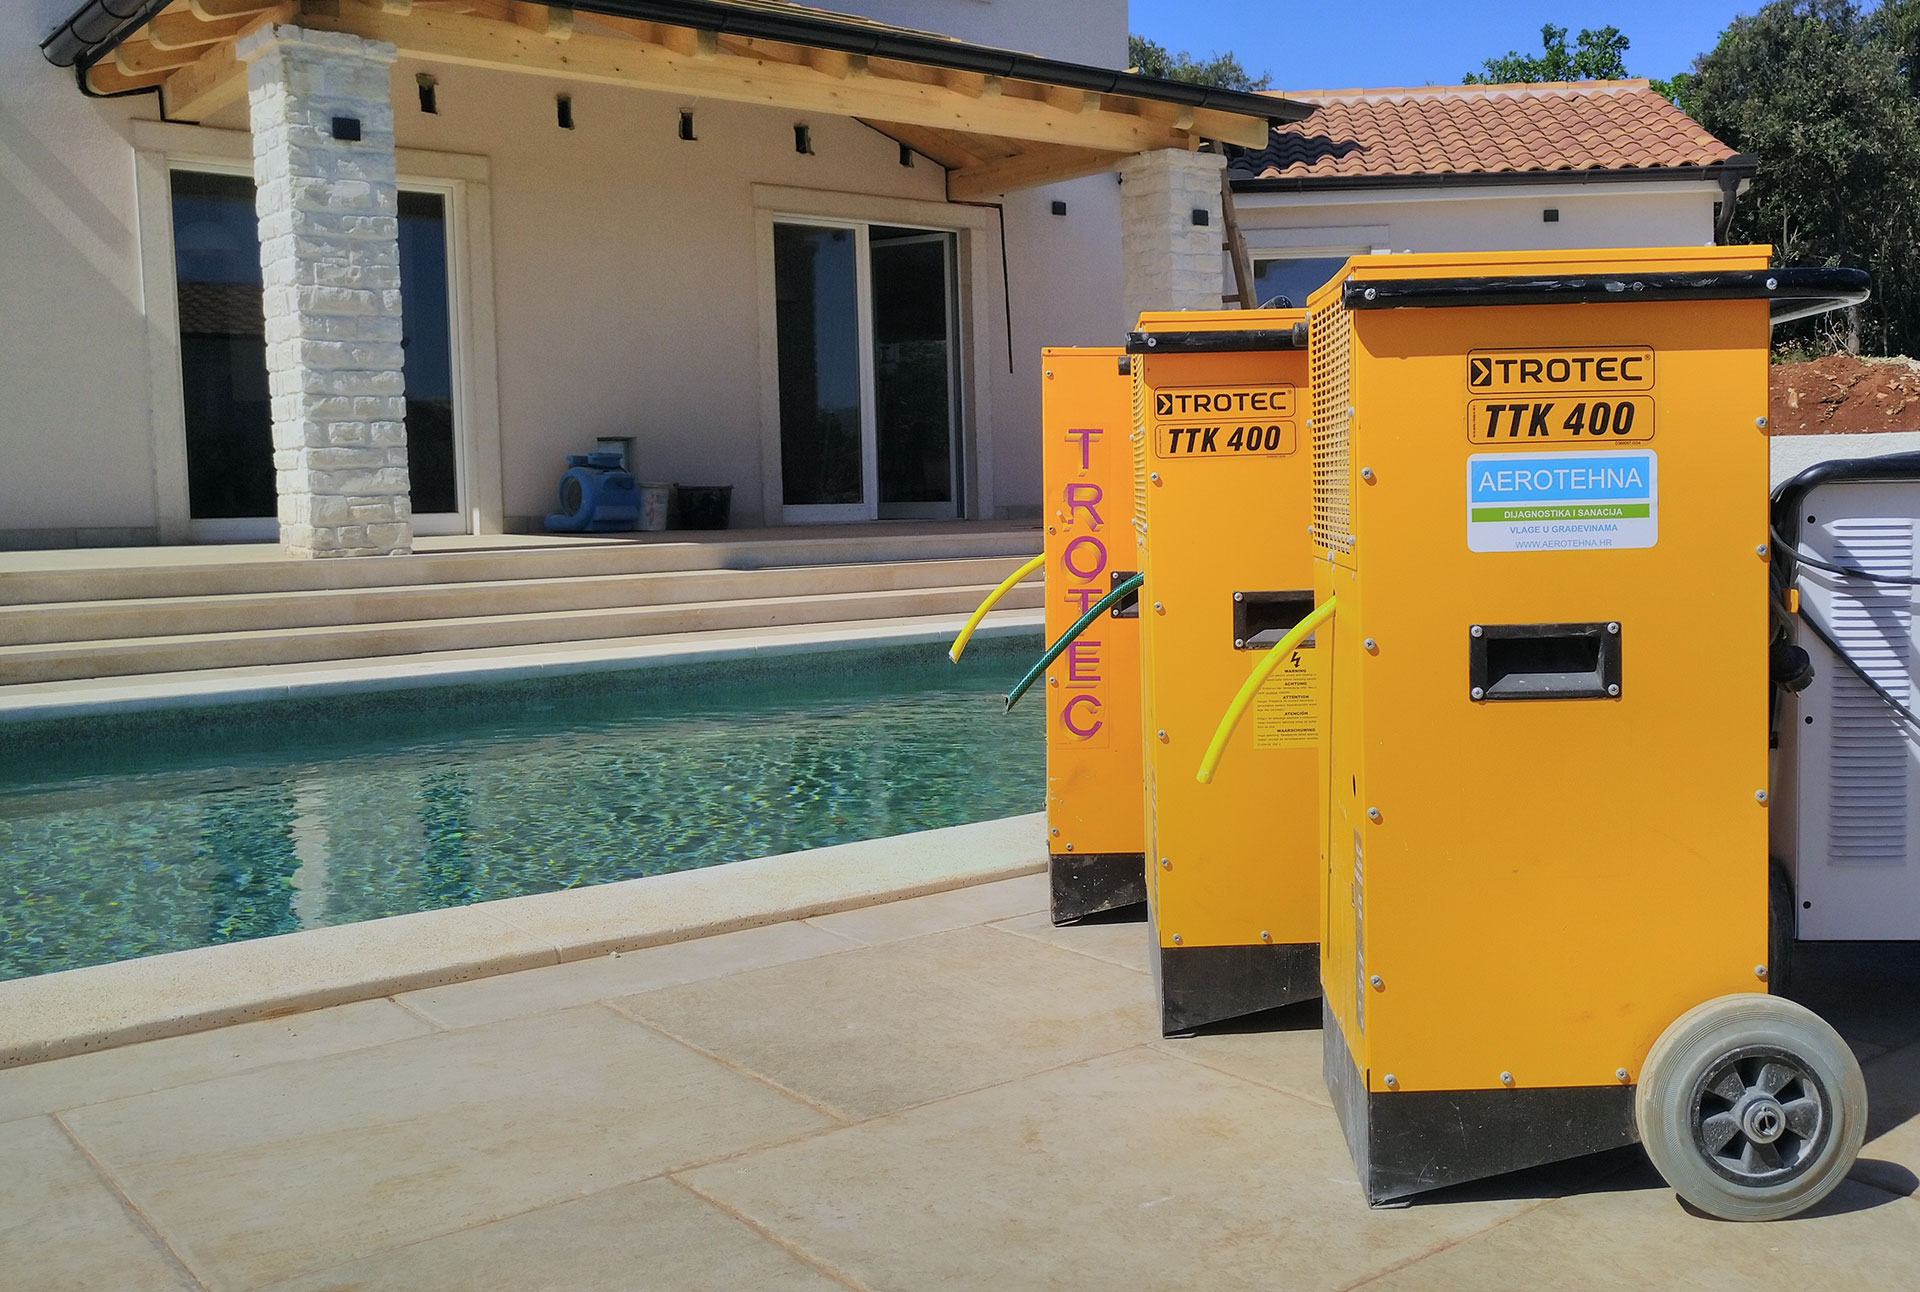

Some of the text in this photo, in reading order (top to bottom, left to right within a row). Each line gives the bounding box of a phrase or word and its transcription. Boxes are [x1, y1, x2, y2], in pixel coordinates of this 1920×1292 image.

[1495, 357, 1643, 384] TROTEC
[1175, 392, 1286, 413] TROTEC
[1485, 403, 1555, 438] TTK
[1563, 401, 1635, 436] 400
[1169, 427, 1220, 454] TTK
[1227, 425, 1281, 451] 400
[1478, 468, 1643, 492] AEROTEHNA
[1504, 509, 1571, 519] DIJAGNOSTIKA
[1577, 508, 1623, 516] SANACIJA
[1510, 523, 1618, 534] VLAGE U GRAĐEVINAMA
[1515, 539, 1612, 548] WWW.AEROTEHNA.HR
